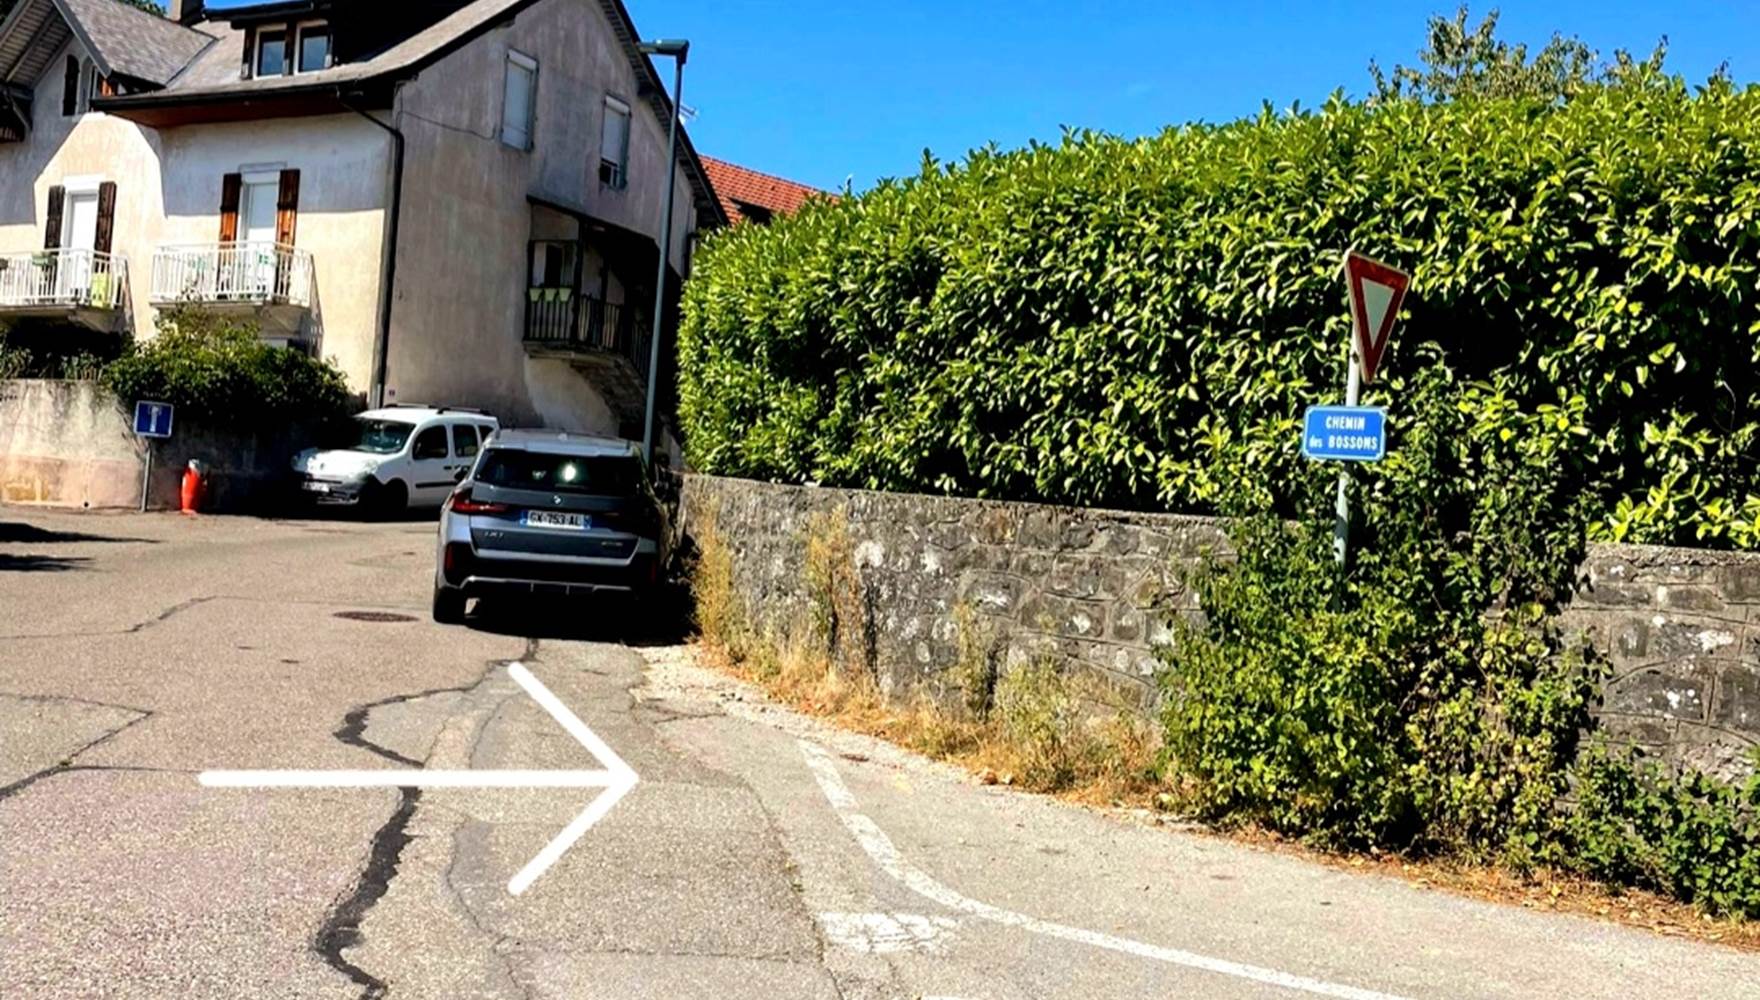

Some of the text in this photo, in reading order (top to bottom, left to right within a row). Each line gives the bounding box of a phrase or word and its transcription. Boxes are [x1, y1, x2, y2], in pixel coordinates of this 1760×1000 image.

[1325, 415, 1366, 431] CHEMIN
[1309, 434, 1378, 450] des BOSSONS
